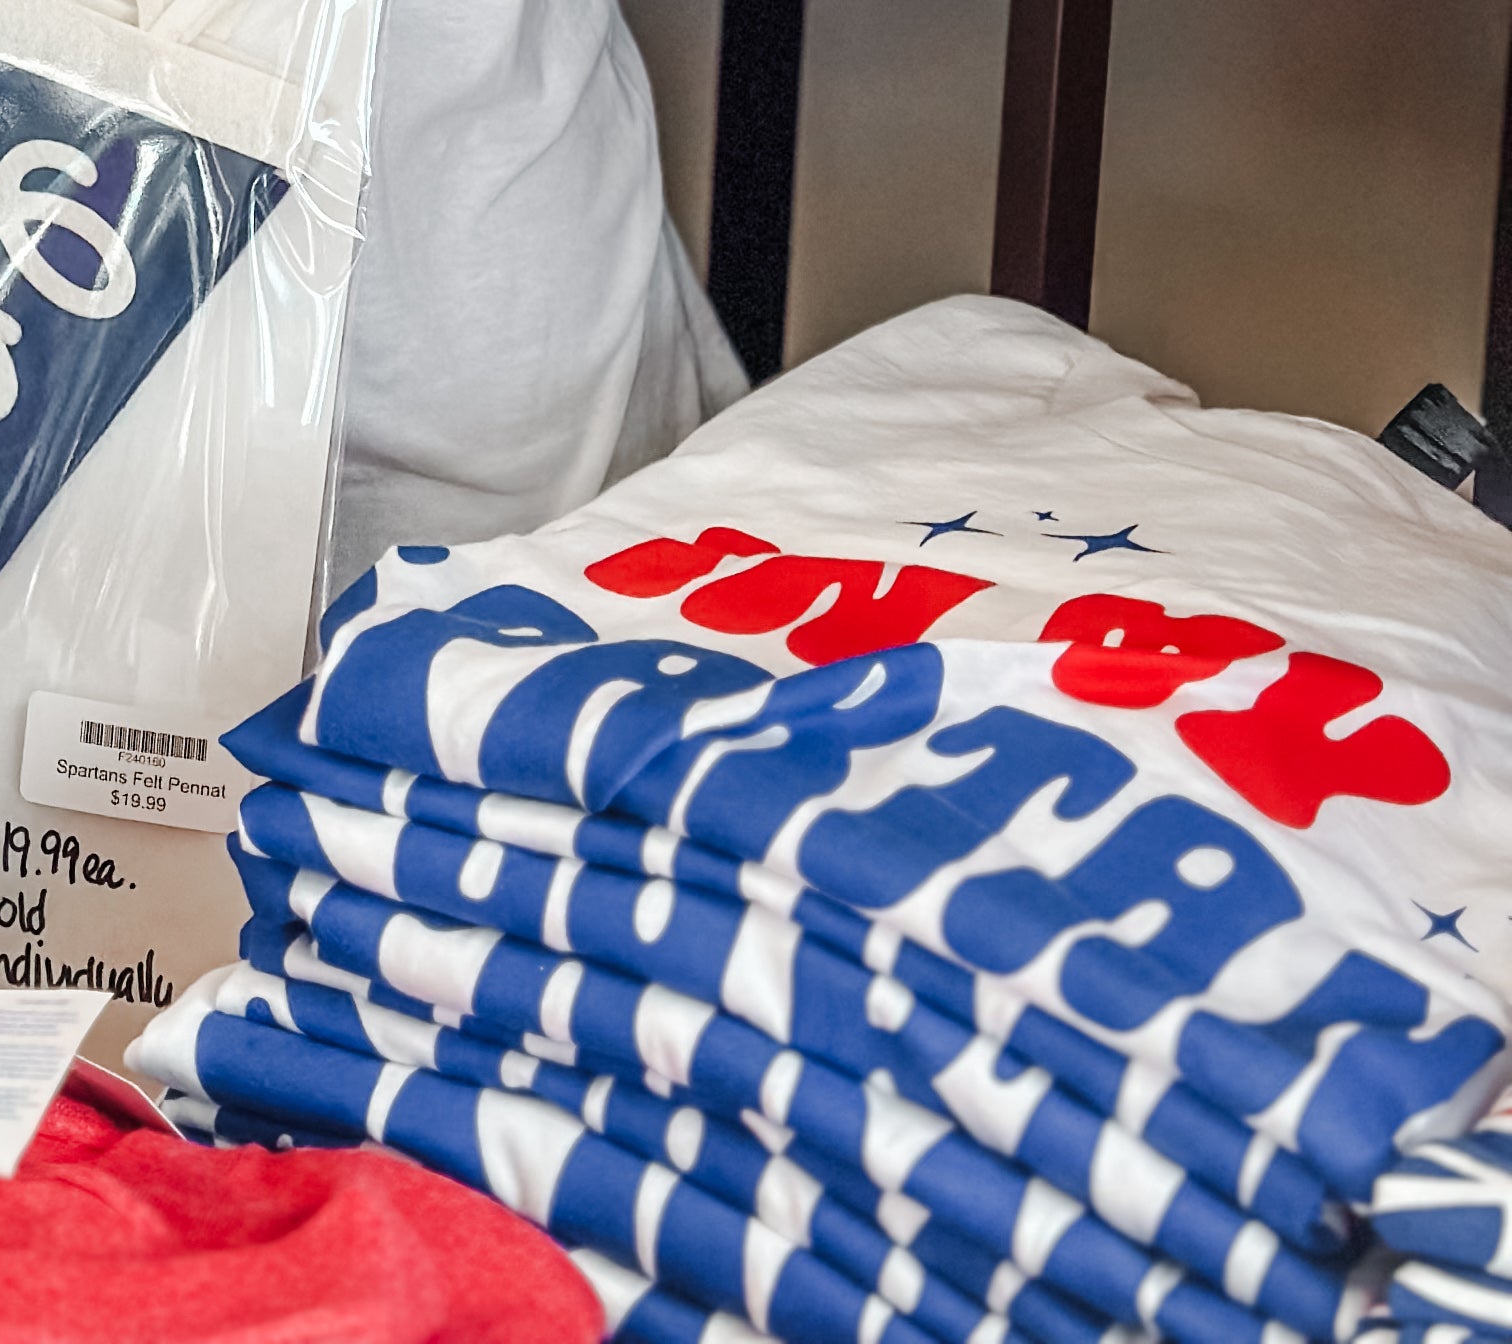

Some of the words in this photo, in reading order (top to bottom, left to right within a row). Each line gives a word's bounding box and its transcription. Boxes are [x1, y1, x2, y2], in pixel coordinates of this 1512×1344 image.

[56, 759, 128, 786] Spartans
[133, 772, 164, 791] Felt
[168, 776, 227, 800] Pennat
[110, 789, 167, 812] $19.99
